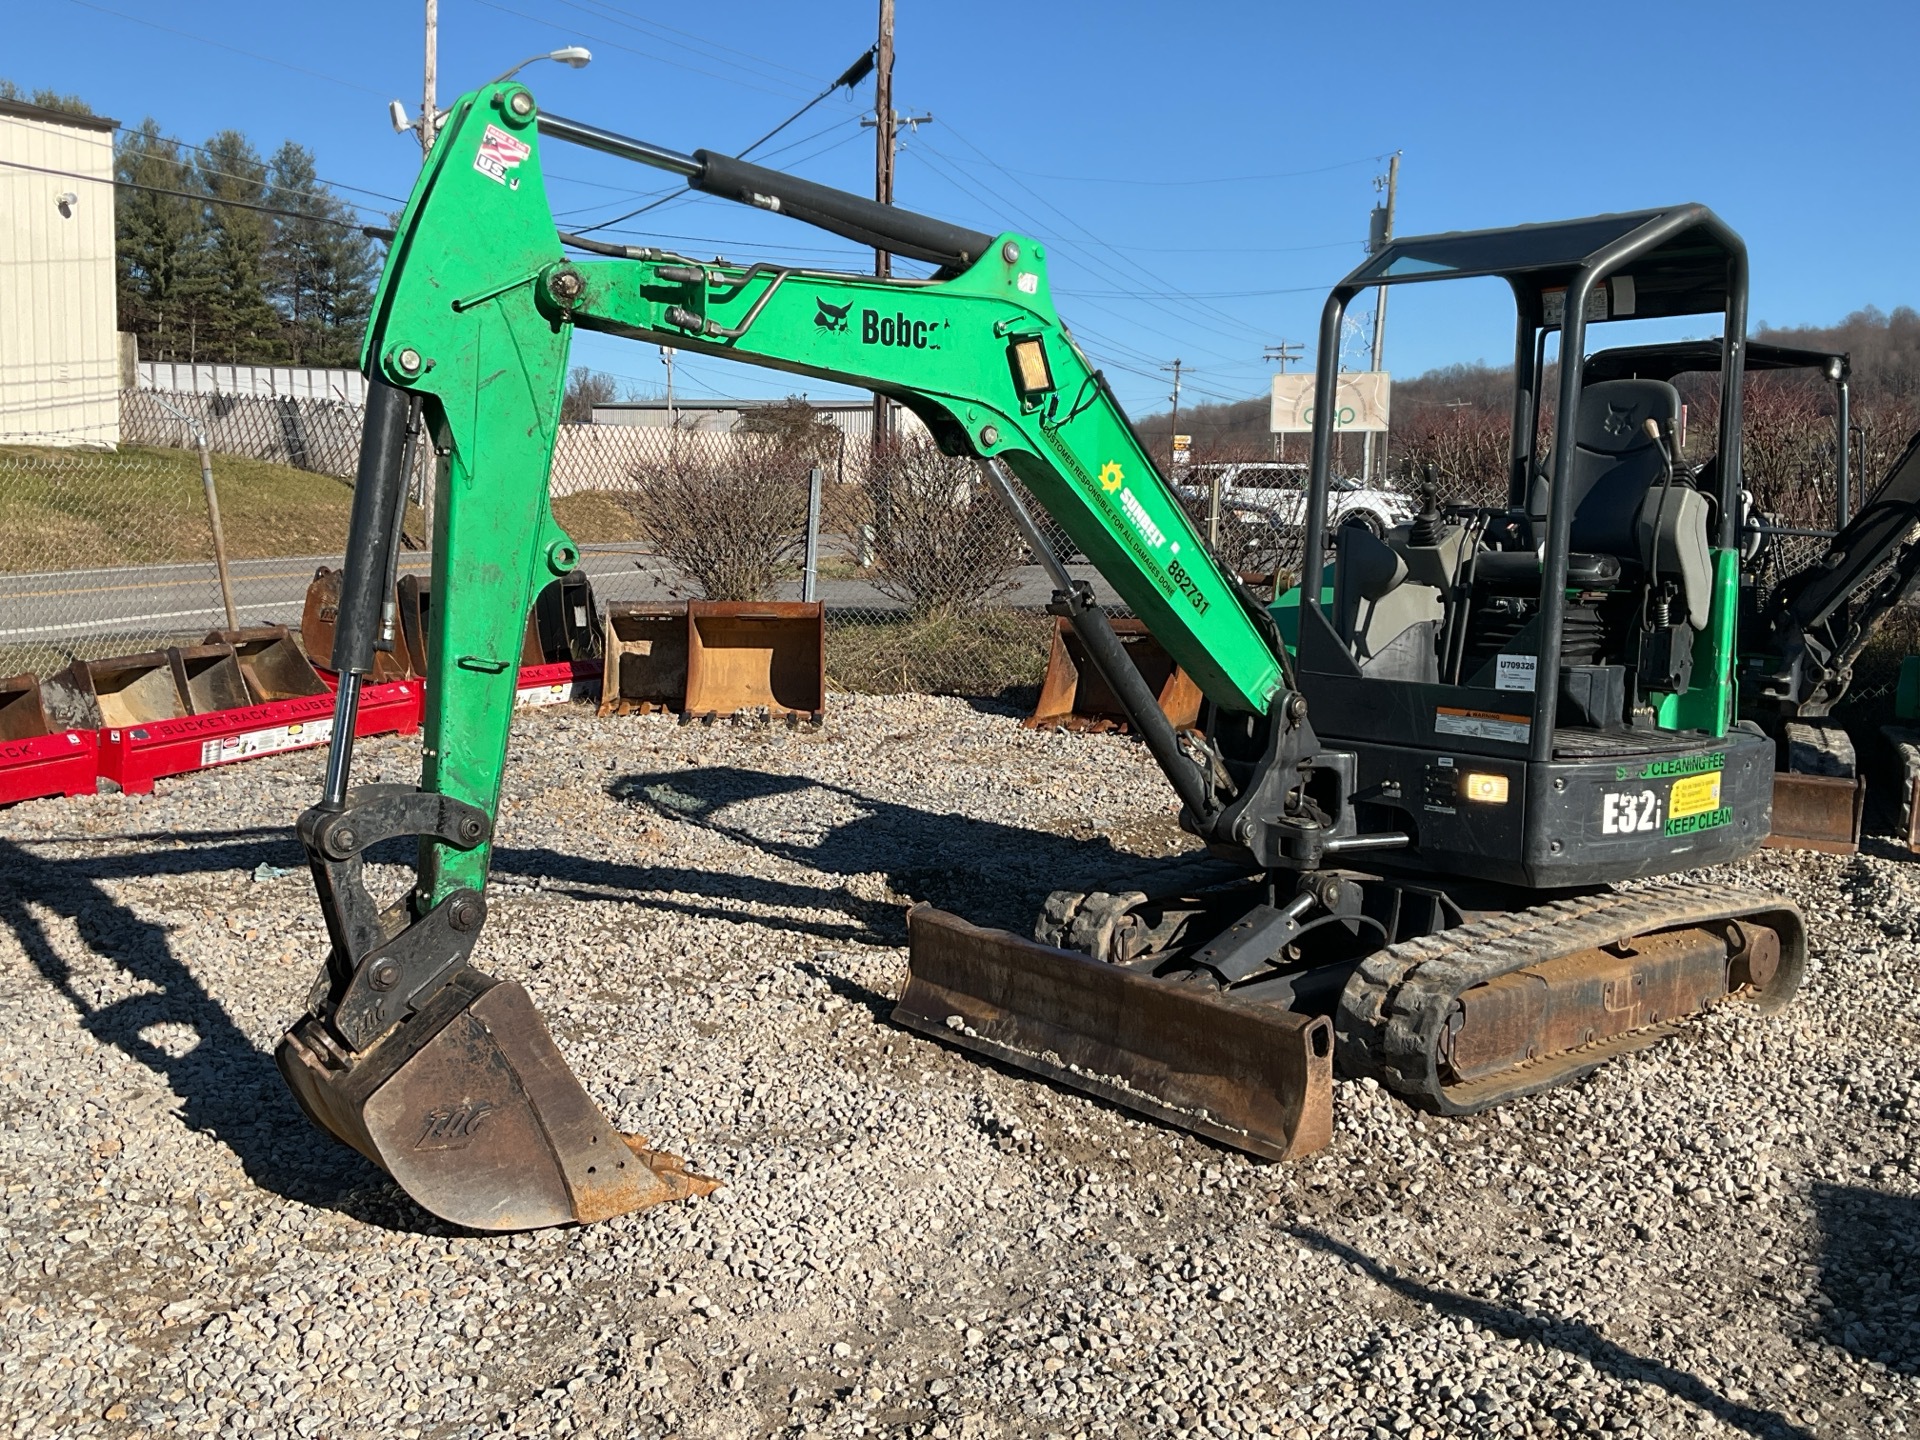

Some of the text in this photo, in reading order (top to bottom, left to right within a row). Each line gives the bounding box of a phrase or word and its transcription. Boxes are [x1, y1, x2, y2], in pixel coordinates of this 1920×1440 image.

[477, 156, 506, 179] US
[862, 309, 950, 350] Bobc
[1043, 425, 1175, 598] CUSTOMER RESPONSIBLE FOR ALL DAMAGES DONE
[1120, 487, 1167, 549] SUNBELT
[1167, 559, 1210, 616] 882731
[1500, 661, 1535, 670] U709326
[160, 716, 227, 735] BUCKET
[231, 709, 272, 725] RACK
[1472, 712, 1500, 720] WARNING
[1651, 757, 1706, 776] CLEANING
[1707, 753, 1725, 769] FEE
[1602, 789, 1662, 834] E32i
[1665, 808, 1732, 836] KEEP CLEAN
